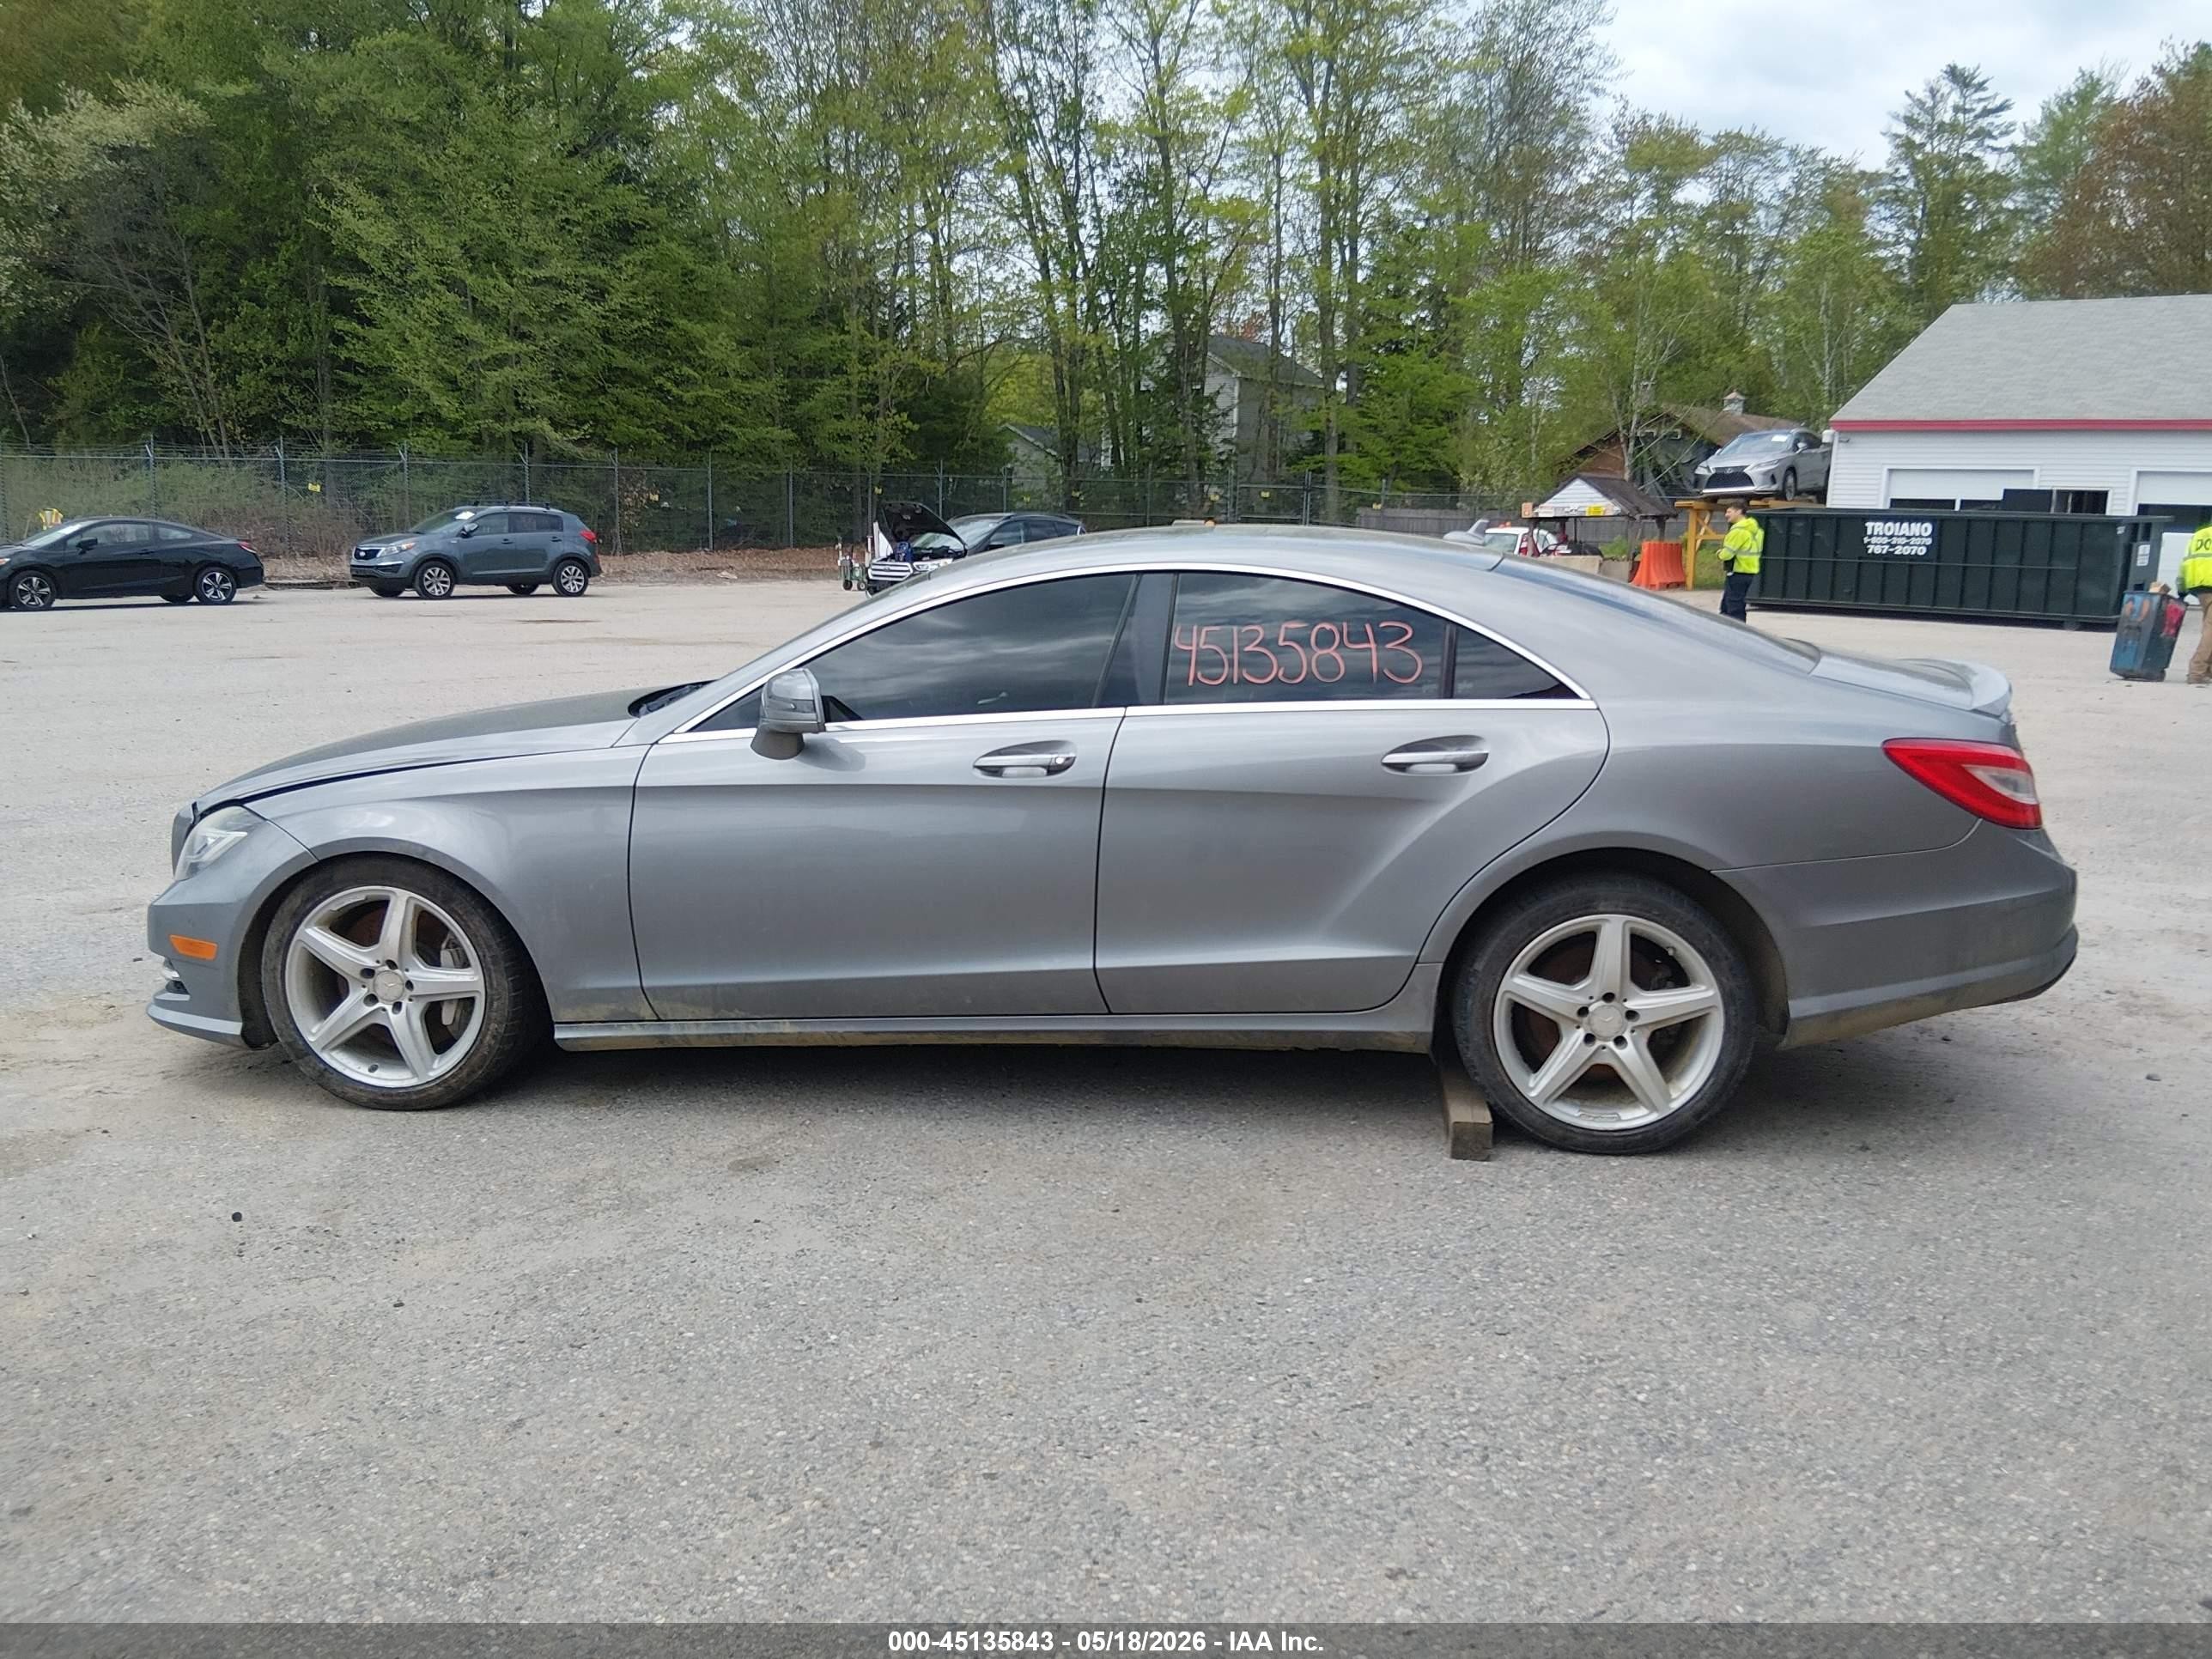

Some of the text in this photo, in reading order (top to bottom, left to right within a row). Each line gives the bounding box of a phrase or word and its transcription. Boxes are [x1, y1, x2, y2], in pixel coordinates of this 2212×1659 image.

[1865, 522, 1933, 537] TROIANO
[1867, 545, 1927, 556] 767-2070
[1174, 621, 1423, 686] 45135843
